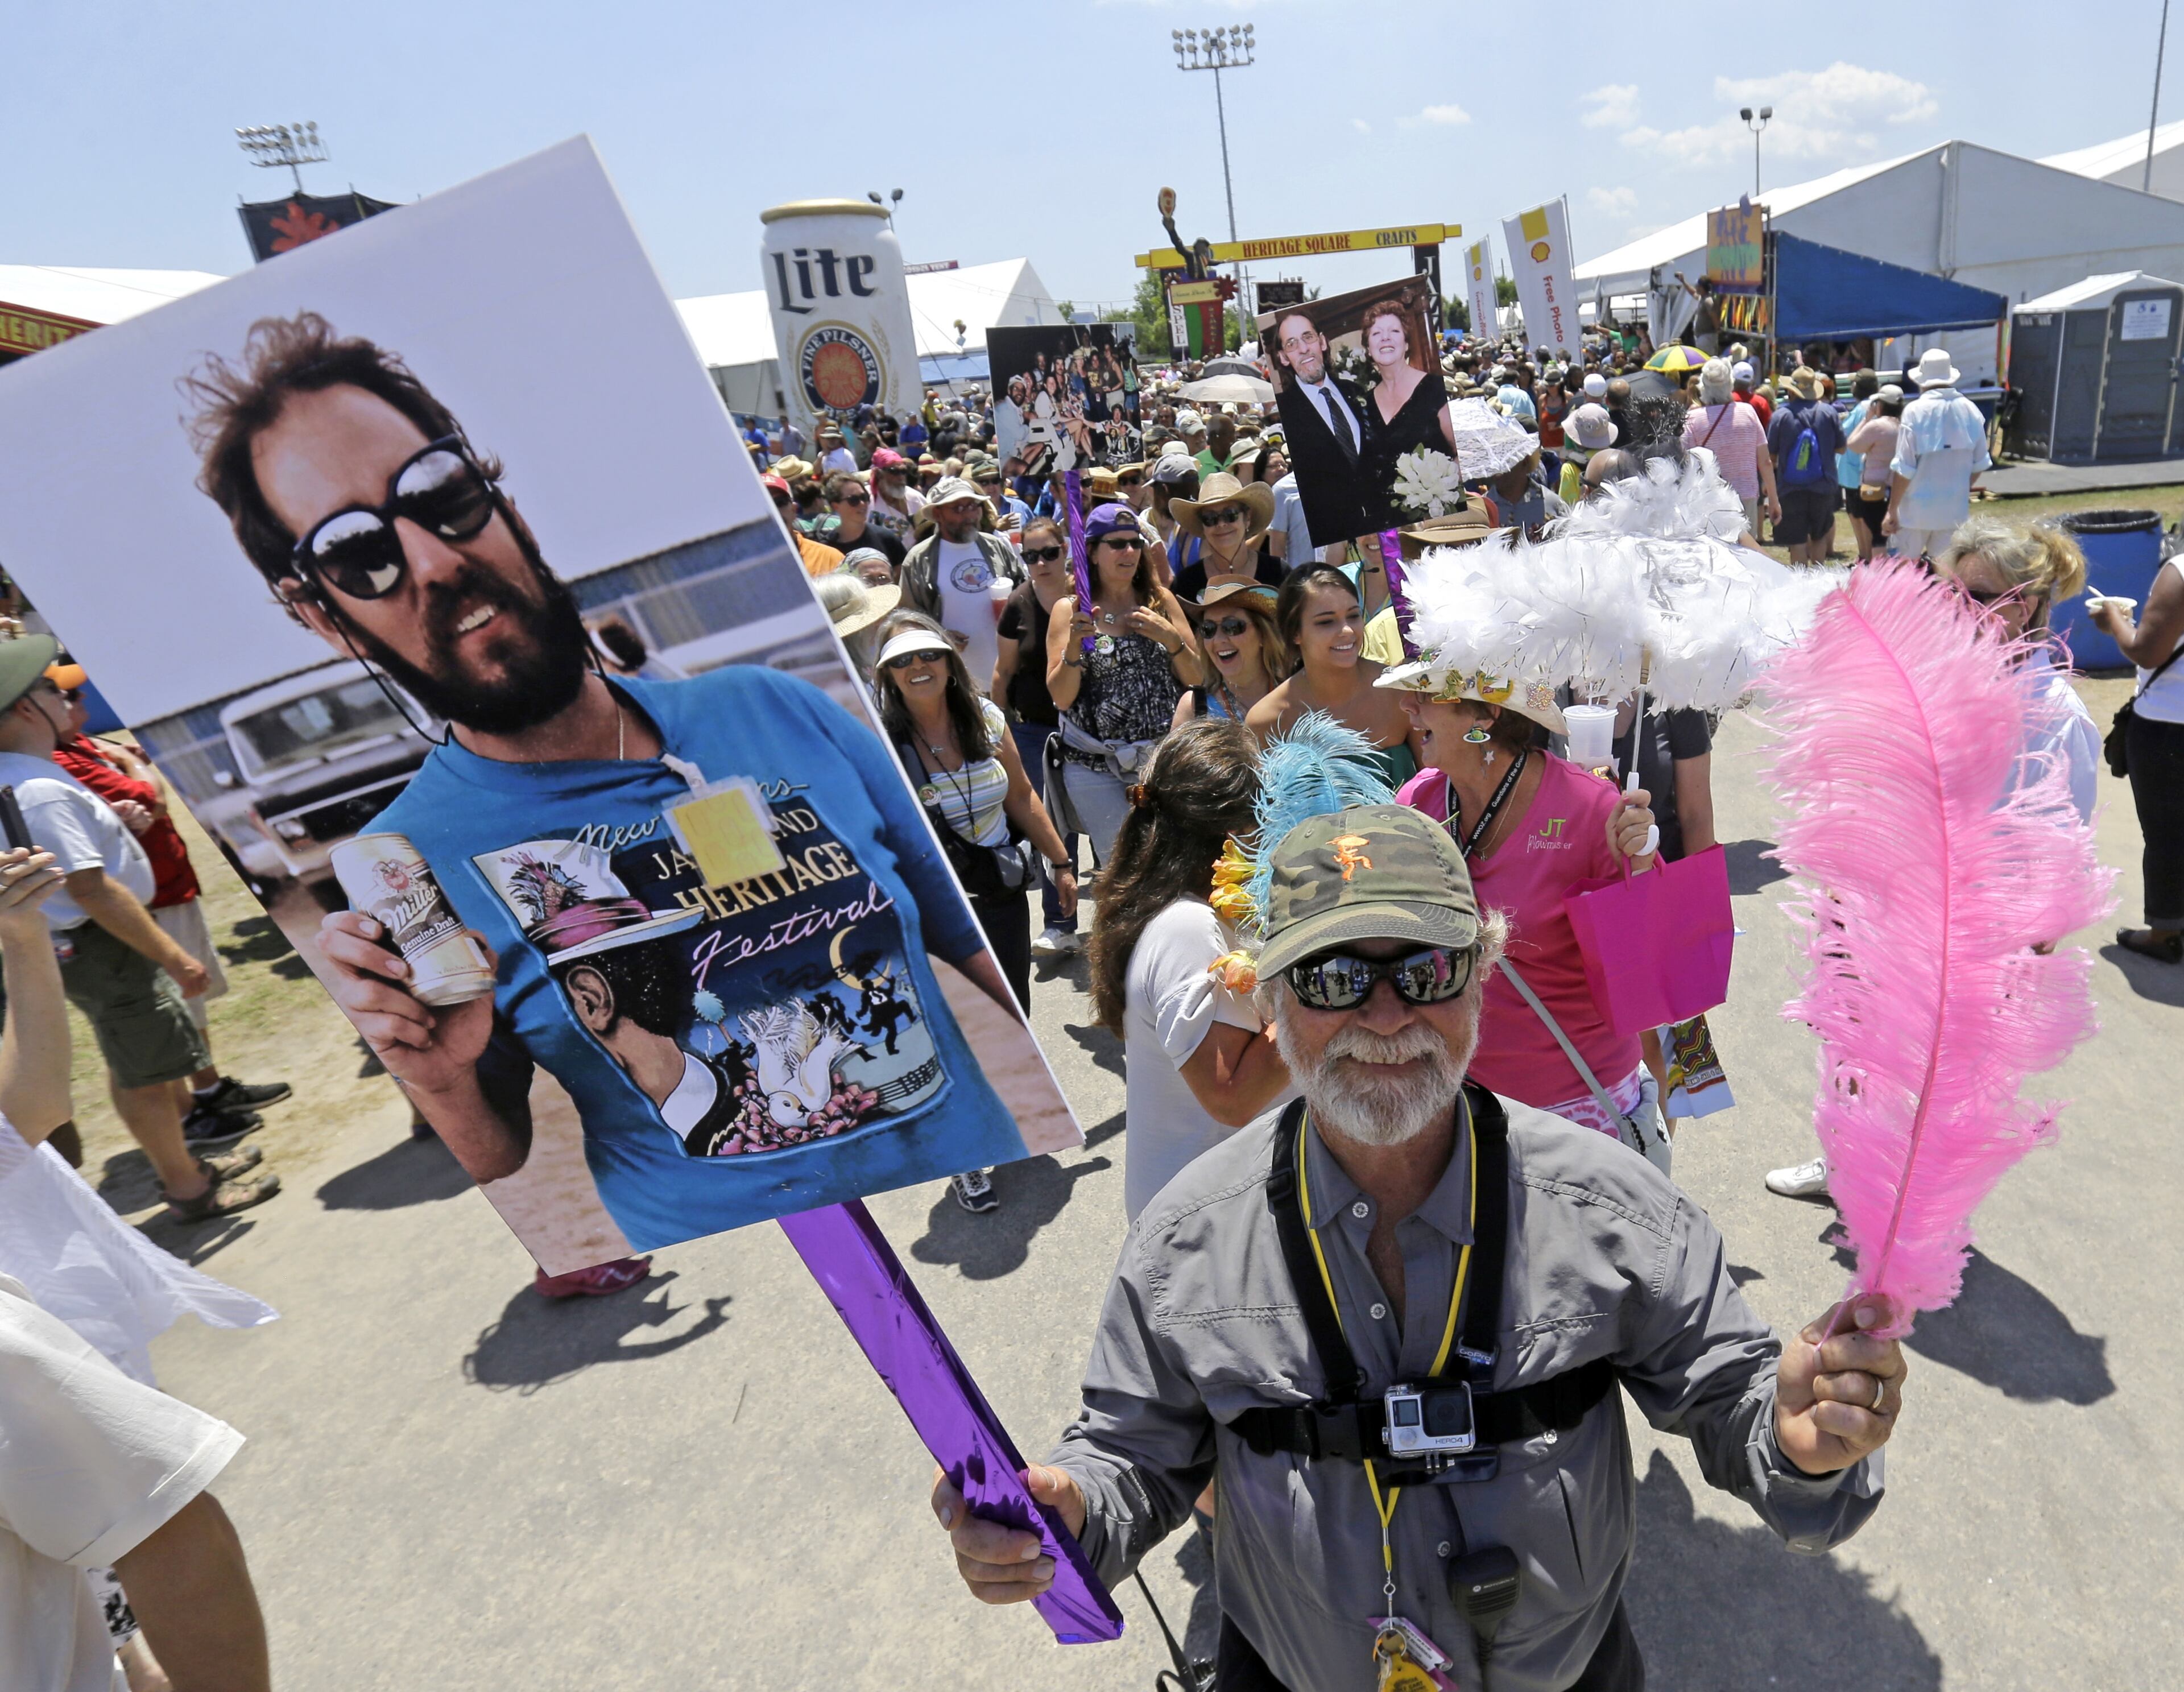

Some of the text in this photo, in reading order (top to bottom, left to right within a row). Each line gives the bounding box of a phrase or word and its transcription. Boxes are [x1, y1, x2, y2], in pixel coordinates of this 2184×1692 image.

[1243, 234, 1351, 258] HERITAGE SQUARE
[1375, 229, 1417, 246] CRAFTS
[770, 247, 876, 314] Lite
[1173, 304, 1186, 345] SPEL
[1543, 275, 1563, 343] Free Photo
[803, 329, 878, 387] A FINE PILSNER
[1472, 812, 1492, 840] WWOZ.org
[1491, 782, 1509, 808] Guardians
[1540, 818, 1567, 837] JT
[553, 816, 661, 864] New
[652, 808, 818, 880] JA ND
[377, 884, 439, 935] Miller
[400, 928, 436, 953] Genuine
[433, 916, 456, 932] Draft
[690, 880, 895, 990] Festival
[1459, 1348, 1492, 1362] GoPro
